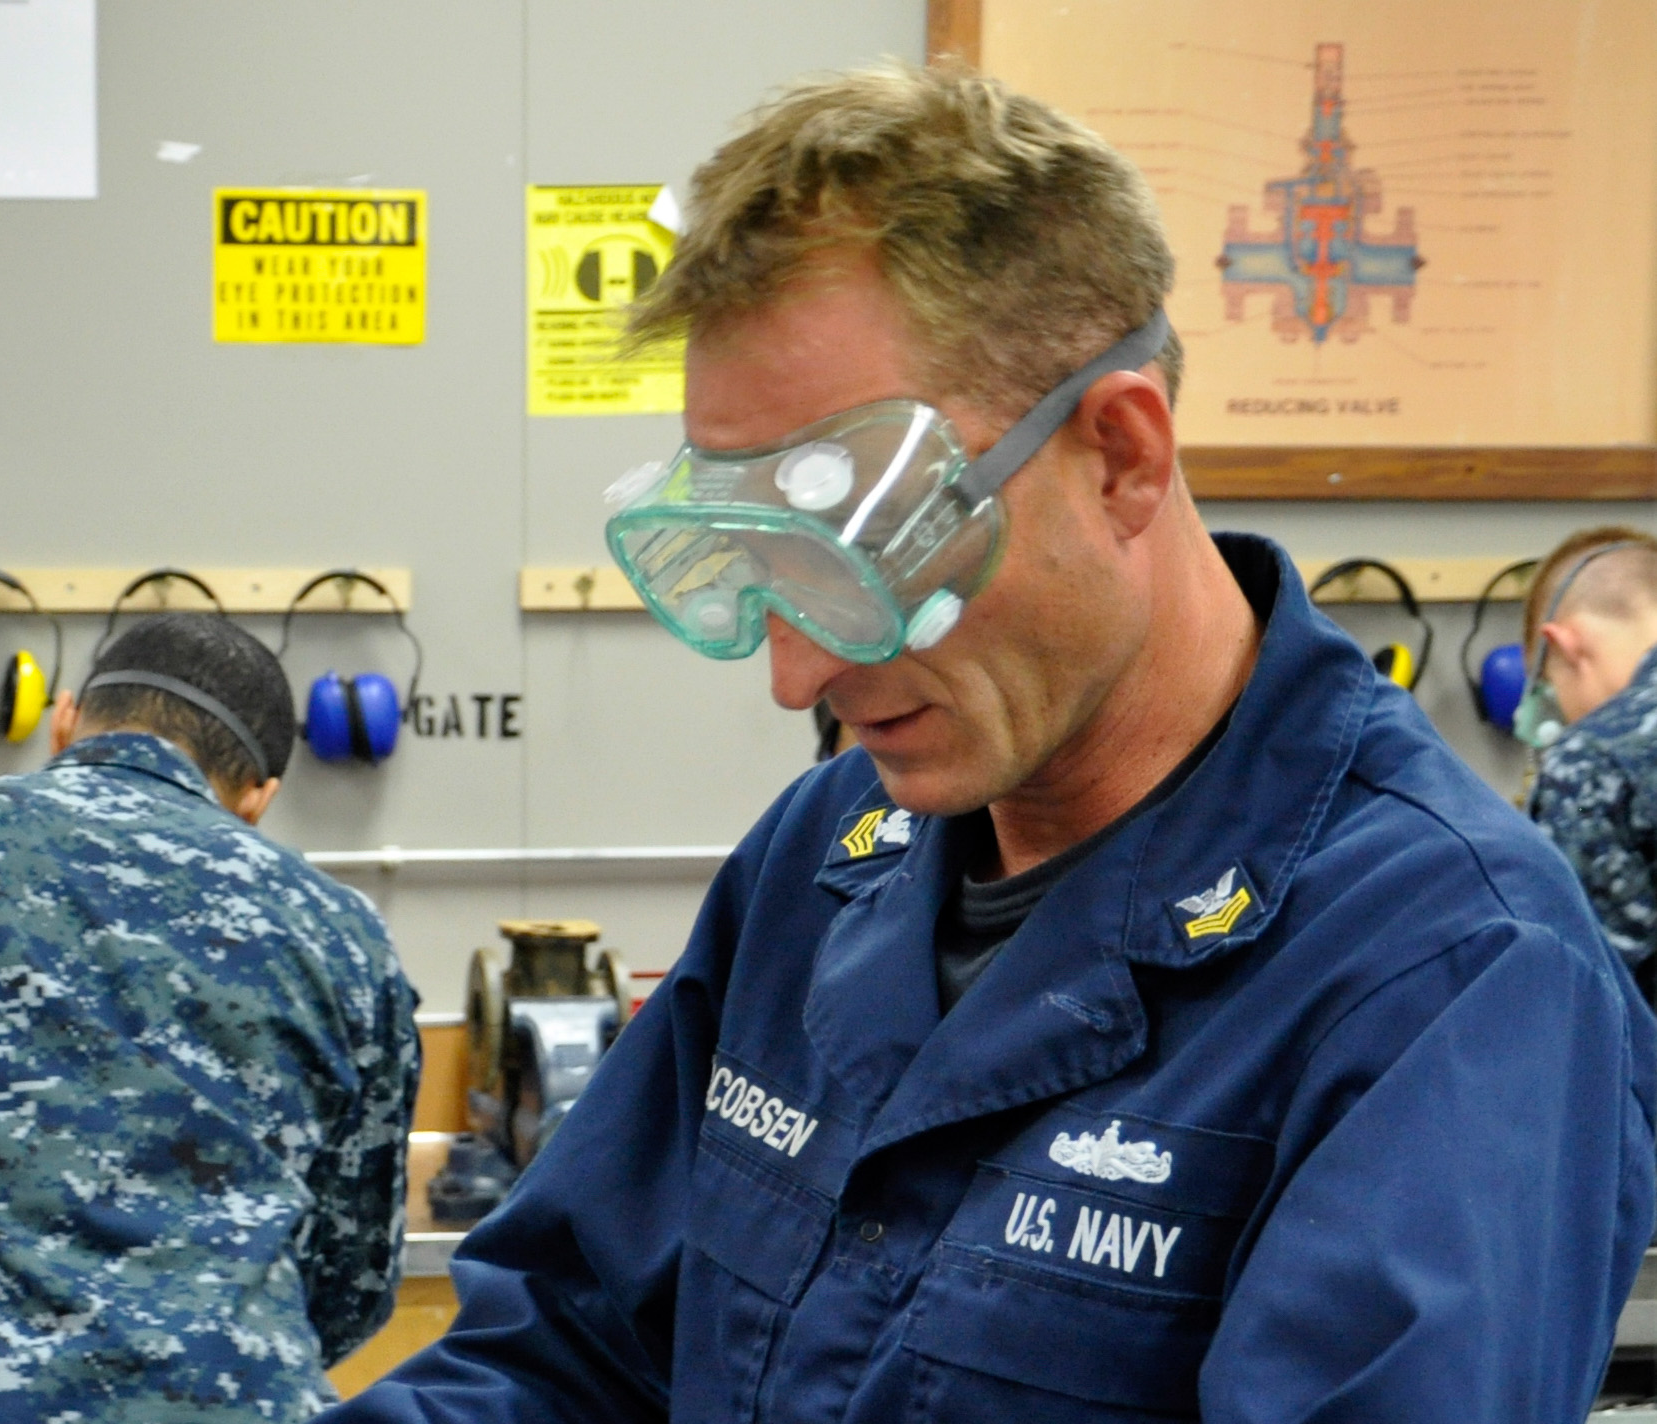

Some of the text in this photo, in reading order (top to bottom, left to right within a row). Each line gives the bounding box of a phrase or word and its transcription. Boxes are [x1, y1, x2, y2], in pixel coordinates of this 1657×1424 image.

[229, 199, 409, 243] CAUTION
[253, 255, 311, 276] WEAR
[219, 280, 416, 304] EYE PROTECTION
[236, 308, 398, 331] IN THIS AREA
[1225, 396, 1400, 415] REDUCING VALVE
[412, 693, 523, 739] GATE
[705, 1062, 819, 1158] COBSEN
[1004, 1192, 1182, 1278] U.S. NAVY
